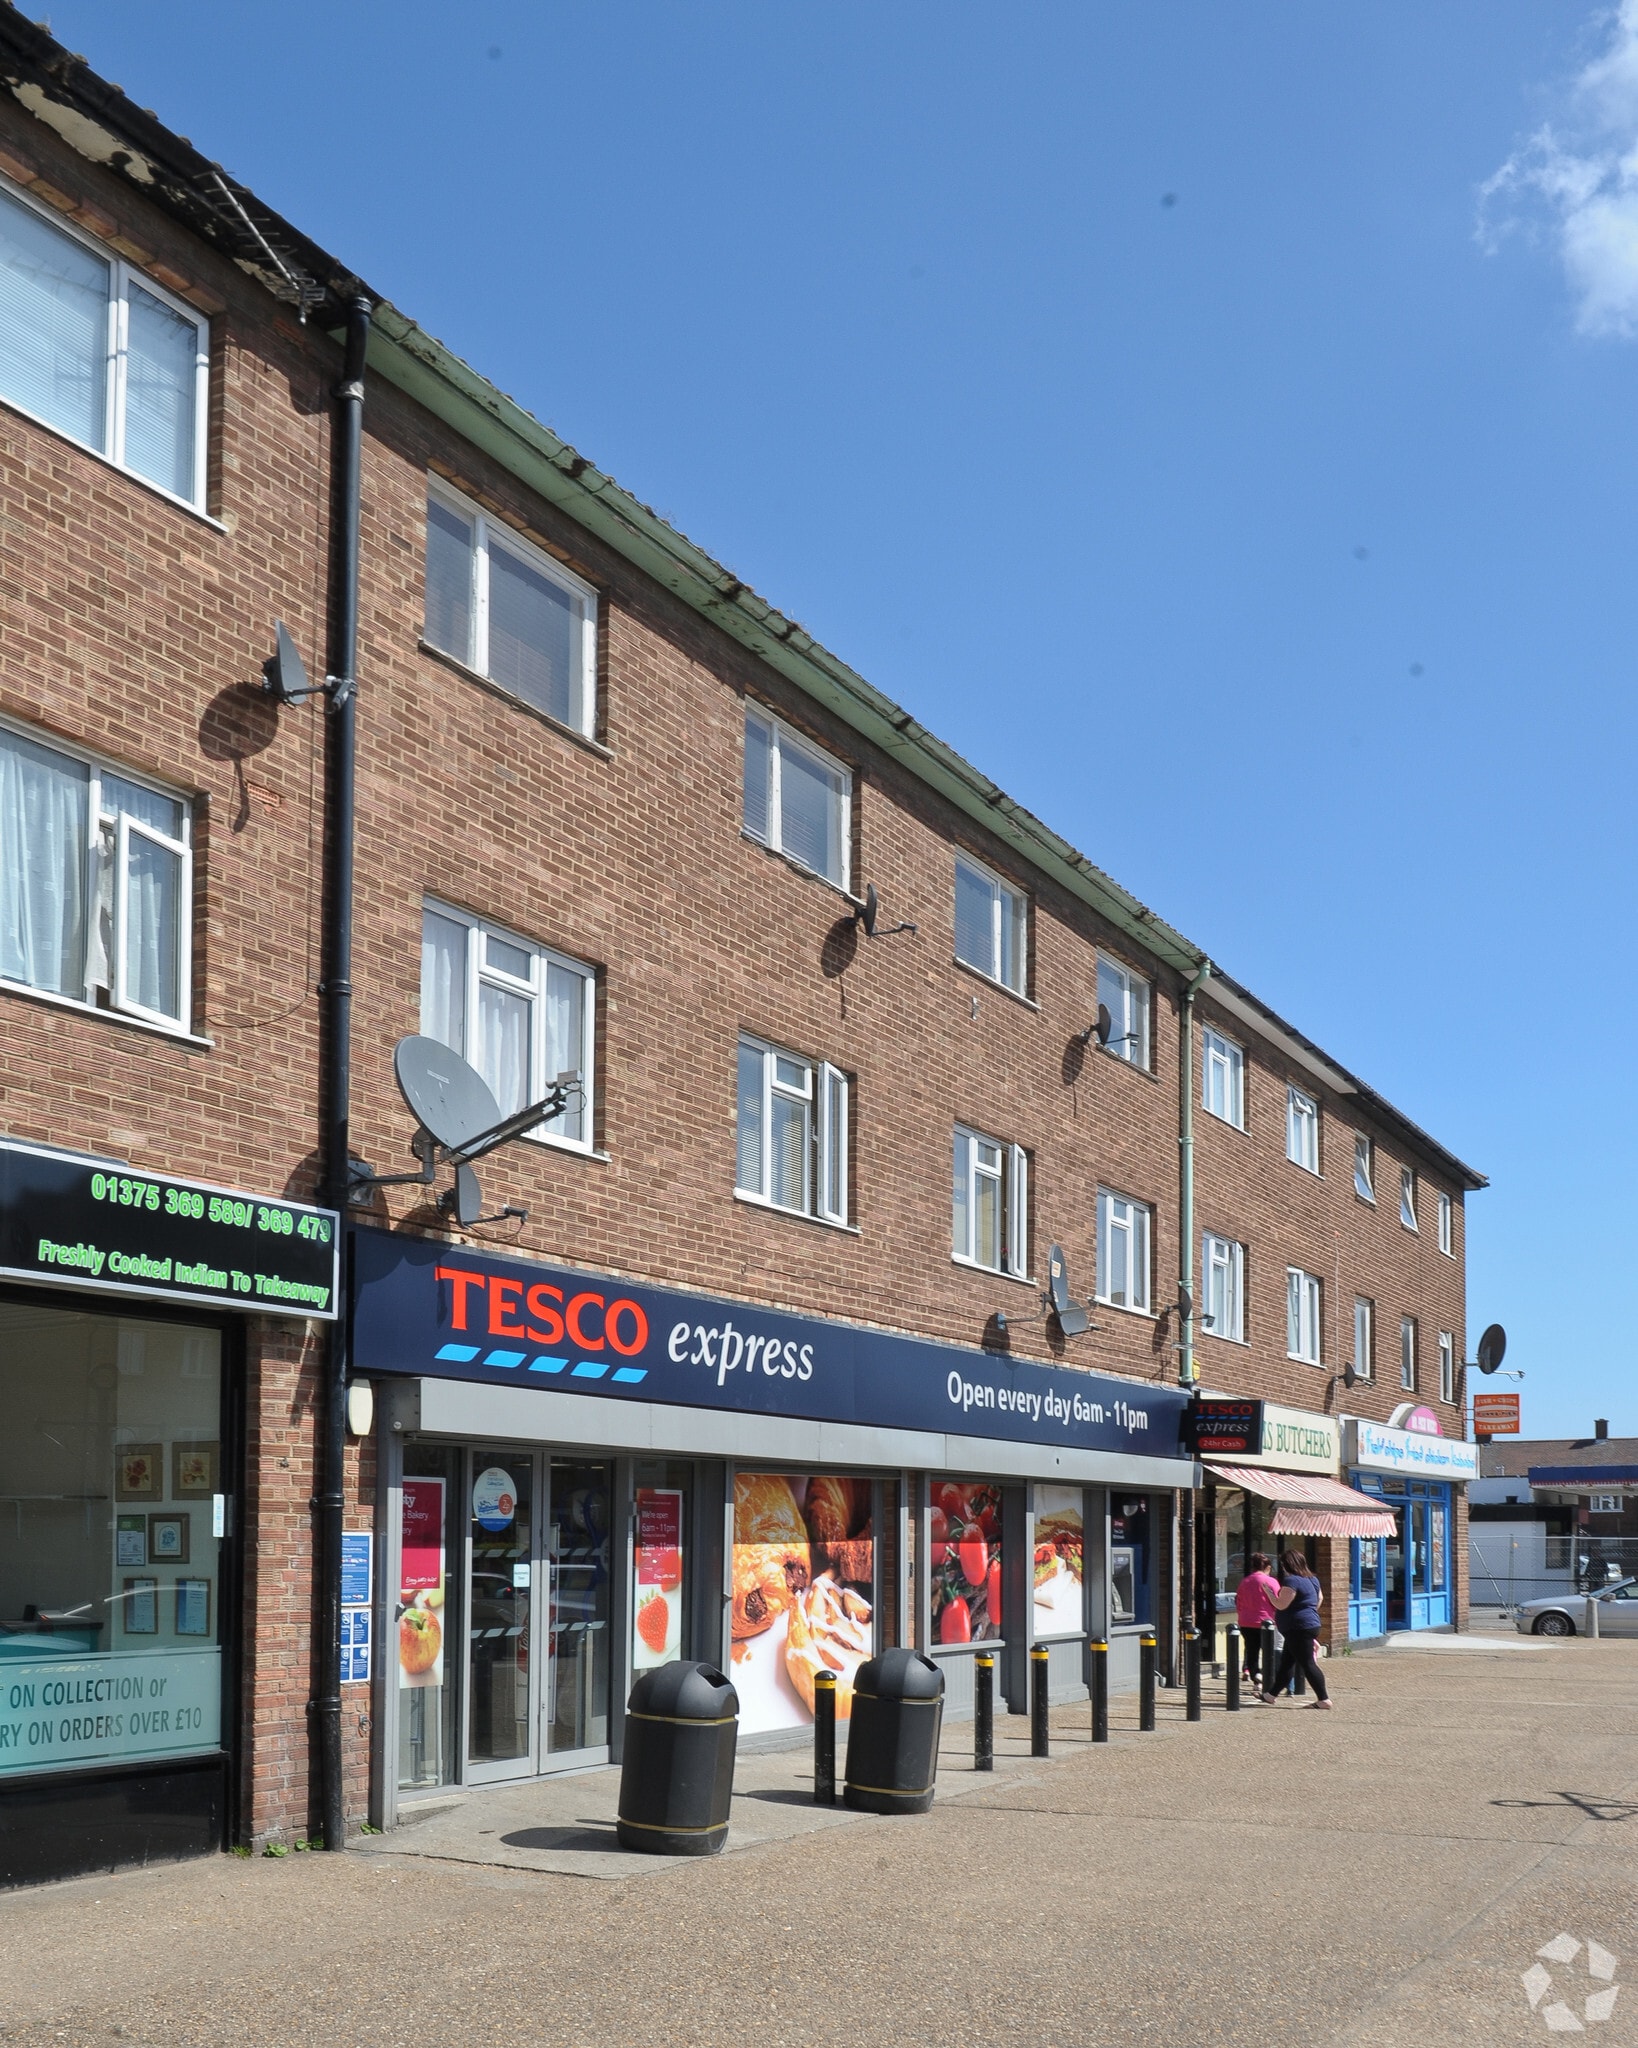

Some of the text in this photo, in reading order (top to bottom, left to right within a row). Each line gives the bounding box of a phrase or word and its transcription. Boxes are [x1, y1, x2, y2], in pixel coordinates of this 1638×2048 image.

[91, 1173, 160, 1211] 01375
[165, 1188, 205, 1219] 369
[257, 1206, 294, 1235] 369
[297, 1214, 332, 1243] 479
[38, 1239, 330, 1309] Freshly Cooked Indian To Takeaway
[434, 1266, 815, 1387] TESCO express
[947, 1370, 995, 1412] Open
[998, 1388, 1041, 1422] every
[1044, 1388, 1072, 1426] day
[1195, 1403, 1254, 1415] TESCO
[1195, 1422, 1250, 1435] express
[1276, 1423, 1332, 1459] BUTCHERS
[407, 1510, 429, 1521] Bakery
[10, 1677, 167, 1709] ON COLLECTION or
[28, 1721, 53, 1746] ON
[60, 1714, 123, 1742] ORDERS
[130, 1710, 169, 1735] OVER
[175, 1707, 202, 1731] £10
